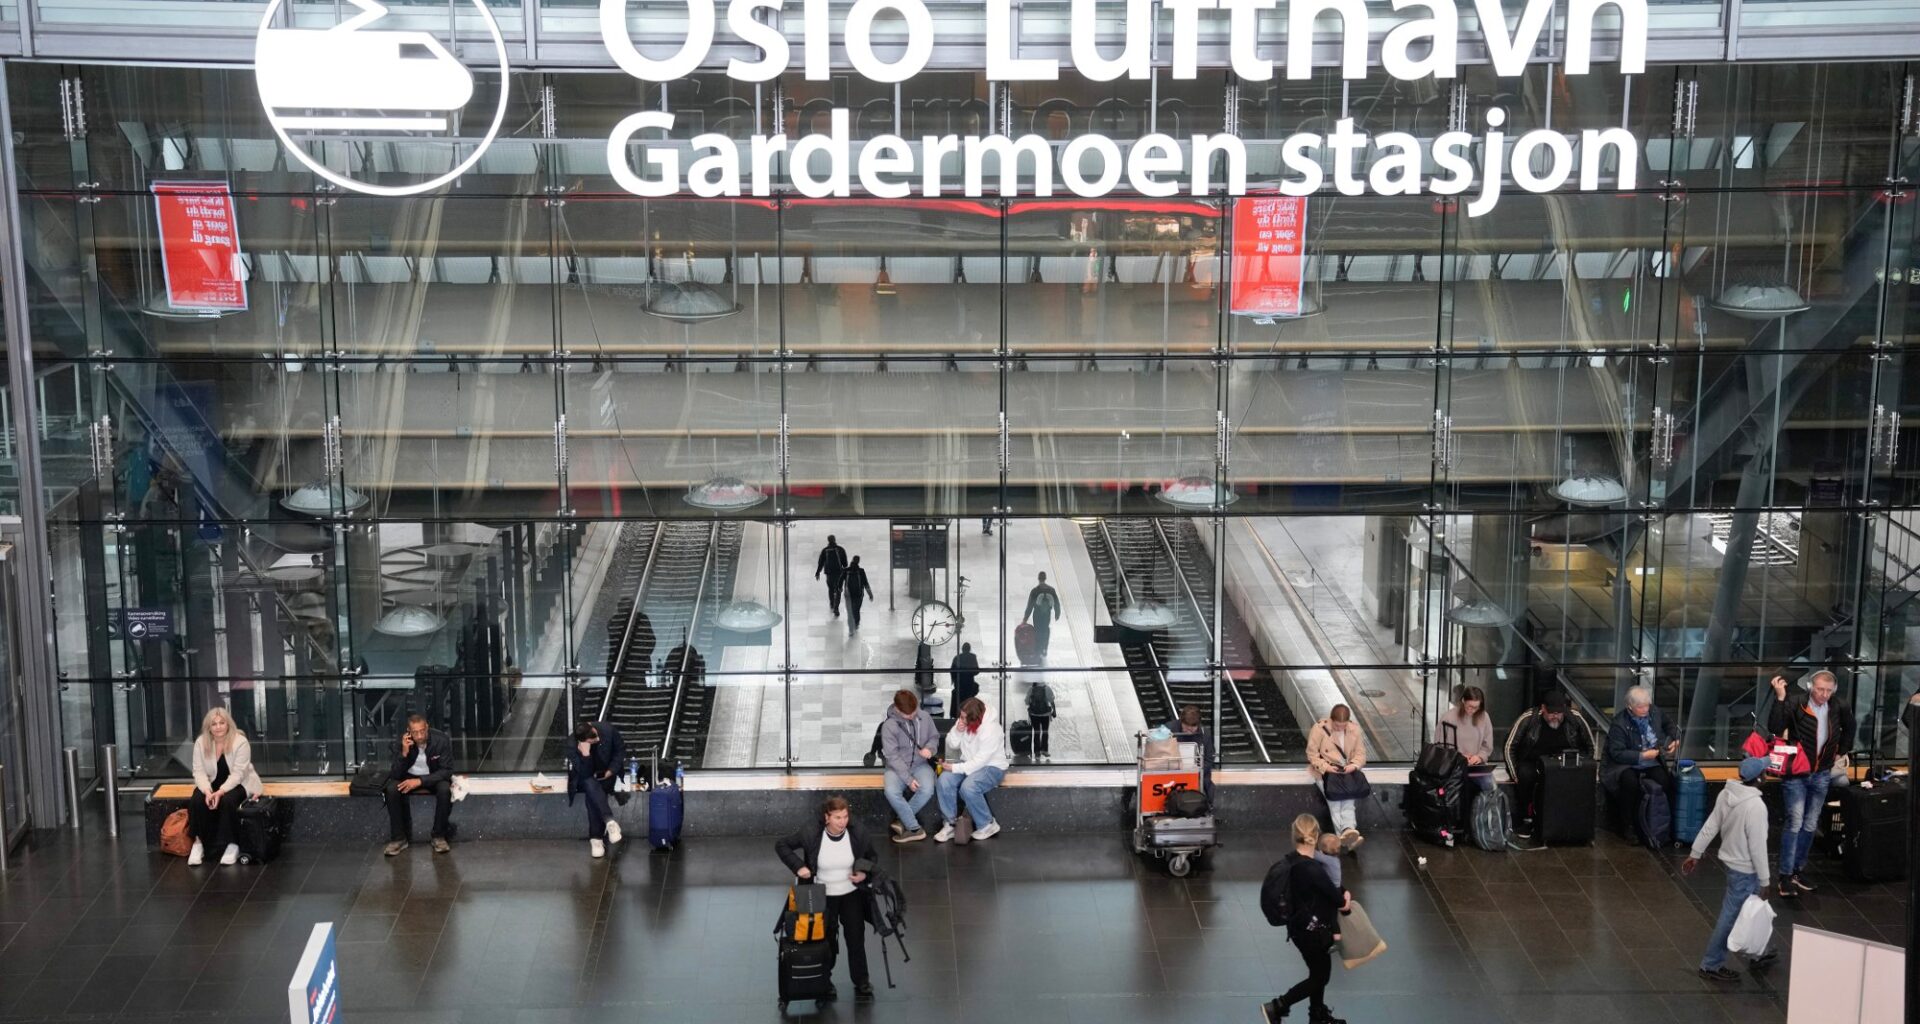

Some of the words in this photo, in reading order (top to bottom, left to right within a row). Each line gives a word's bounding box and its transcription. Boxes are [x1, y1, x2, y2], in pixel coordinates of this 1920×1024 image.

[599, 0, 935, 83] Oslo
[985, 0, 1649, 82] Lufthavn
[606, 107, 1247, 199] Gardermoen
[1279, 106, 1639, 218] stasjon
